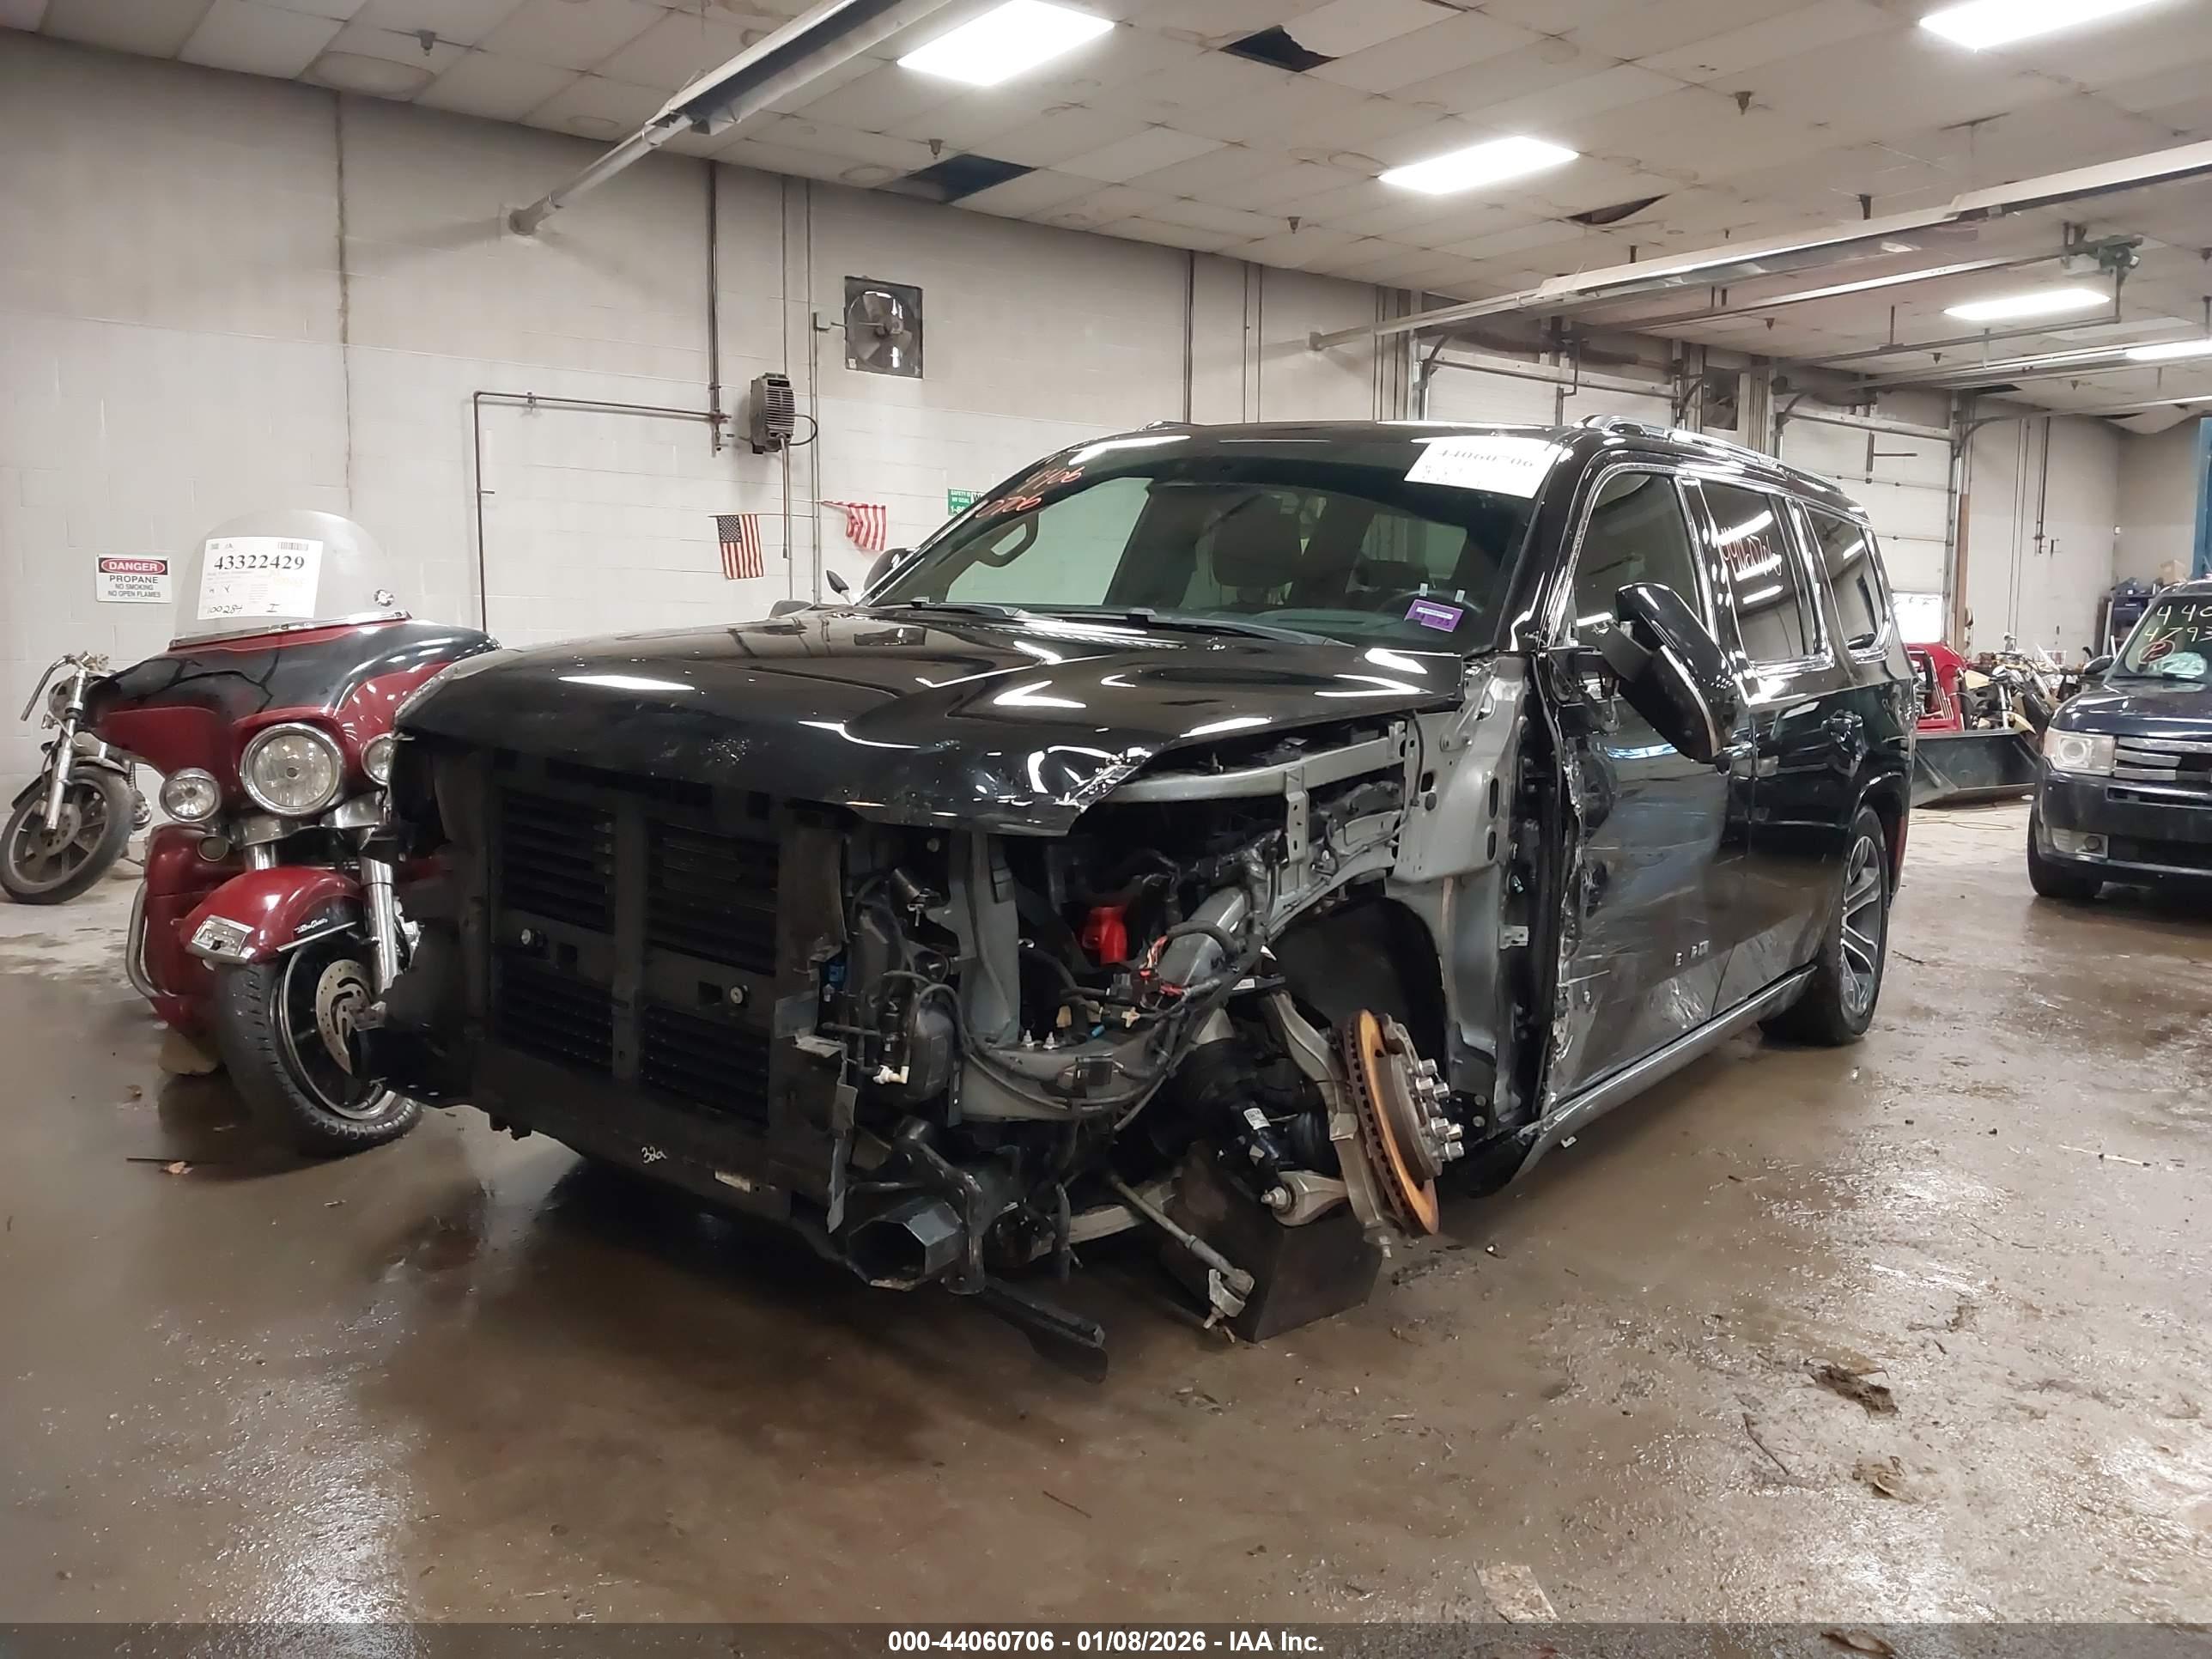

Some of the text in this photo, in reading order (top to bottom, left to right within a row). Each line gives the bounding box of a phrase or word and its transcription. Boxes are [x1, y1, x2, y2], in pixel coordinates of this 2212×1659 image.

[109, 562, 158, 571] DANGER
[214, 555, 305, 569] 43322429
[109, 574, 159, 584] PROPANE
